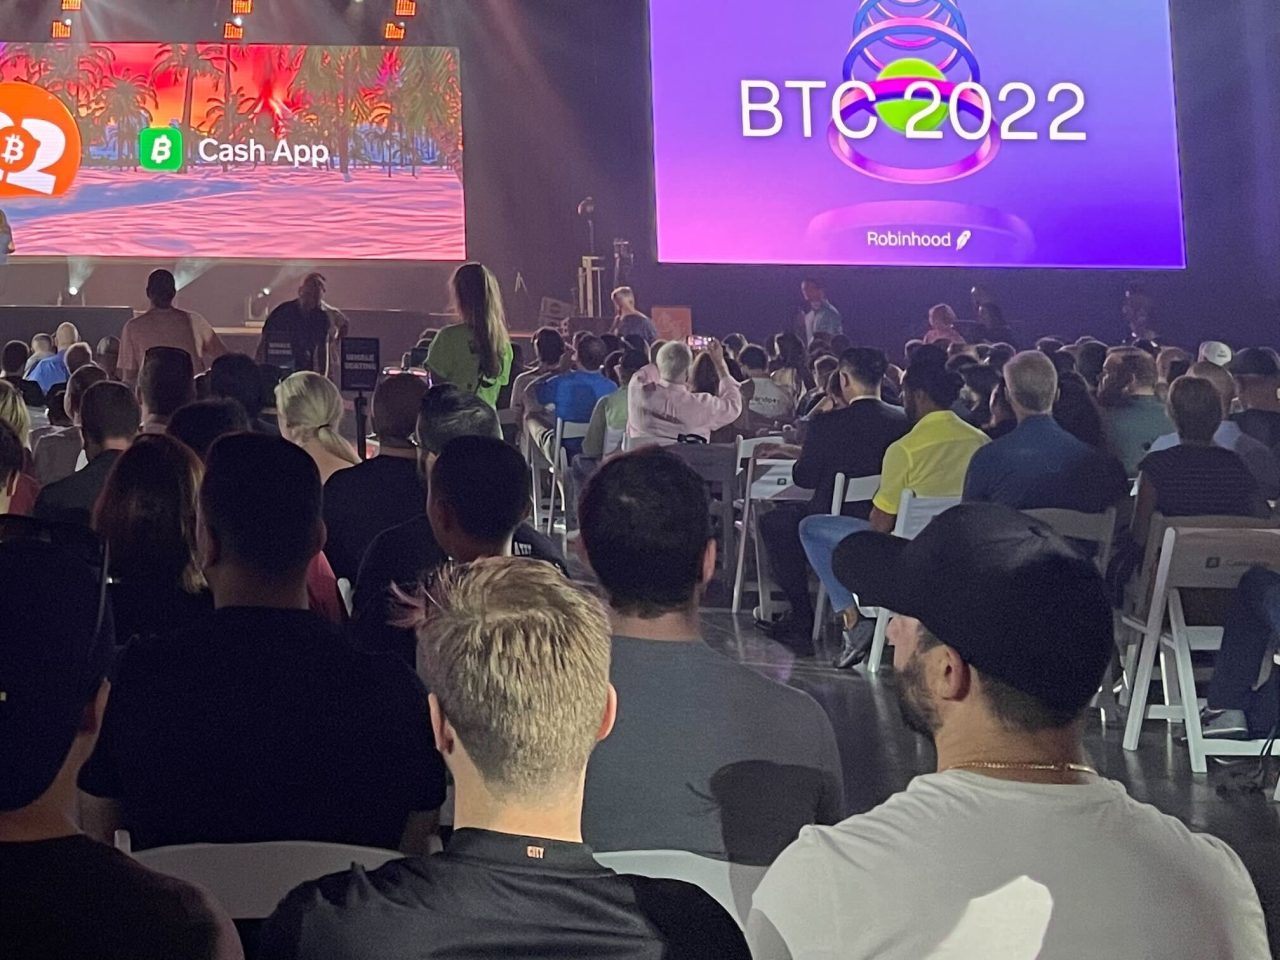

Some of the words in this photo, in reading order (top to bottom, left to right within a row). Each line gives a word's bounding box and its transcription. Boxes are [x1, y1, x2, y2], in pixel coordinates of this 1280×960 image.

[740, 79, 879, 140] BTC
[903, 81, 1089, 142] 2022
[198, 137, 266, 162] Cash
[272, 138, 330, 168] App
[867, 230, 952, 248] Robinhood
